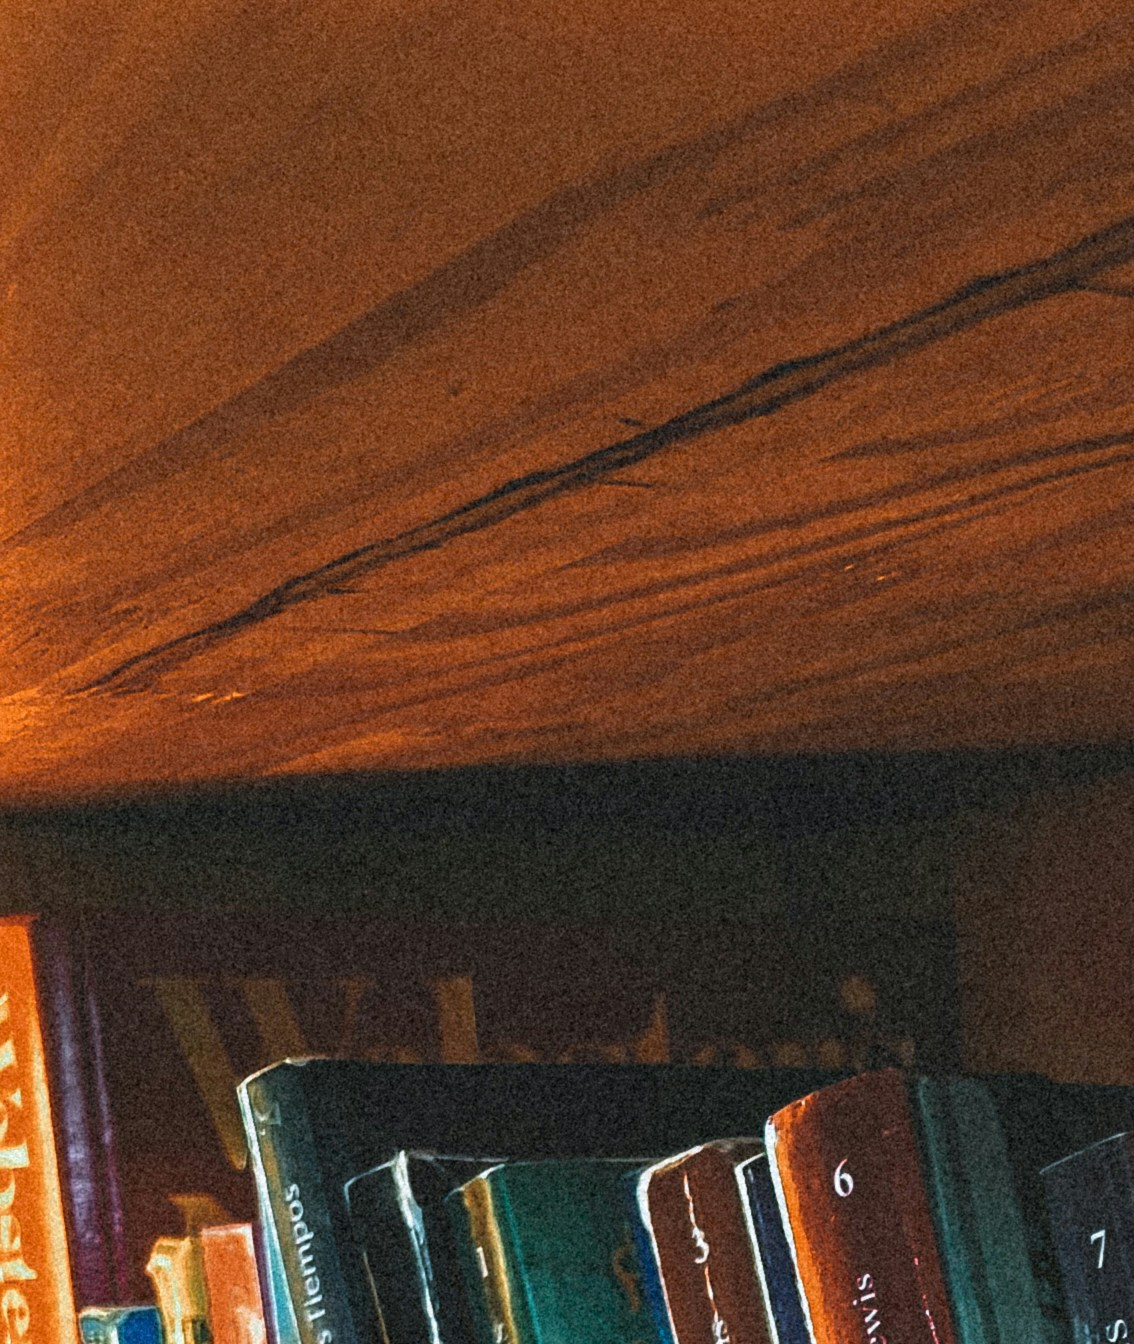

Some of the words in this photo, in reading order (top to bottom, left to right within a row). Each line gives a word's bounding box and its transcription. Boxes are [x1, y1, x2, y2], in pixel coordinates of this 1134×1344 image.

[832, 1159, 854, 1198] 6
[281, 1184, 326, 1330] Tiempos
[1089, 1228, 1107, 1269] 7
